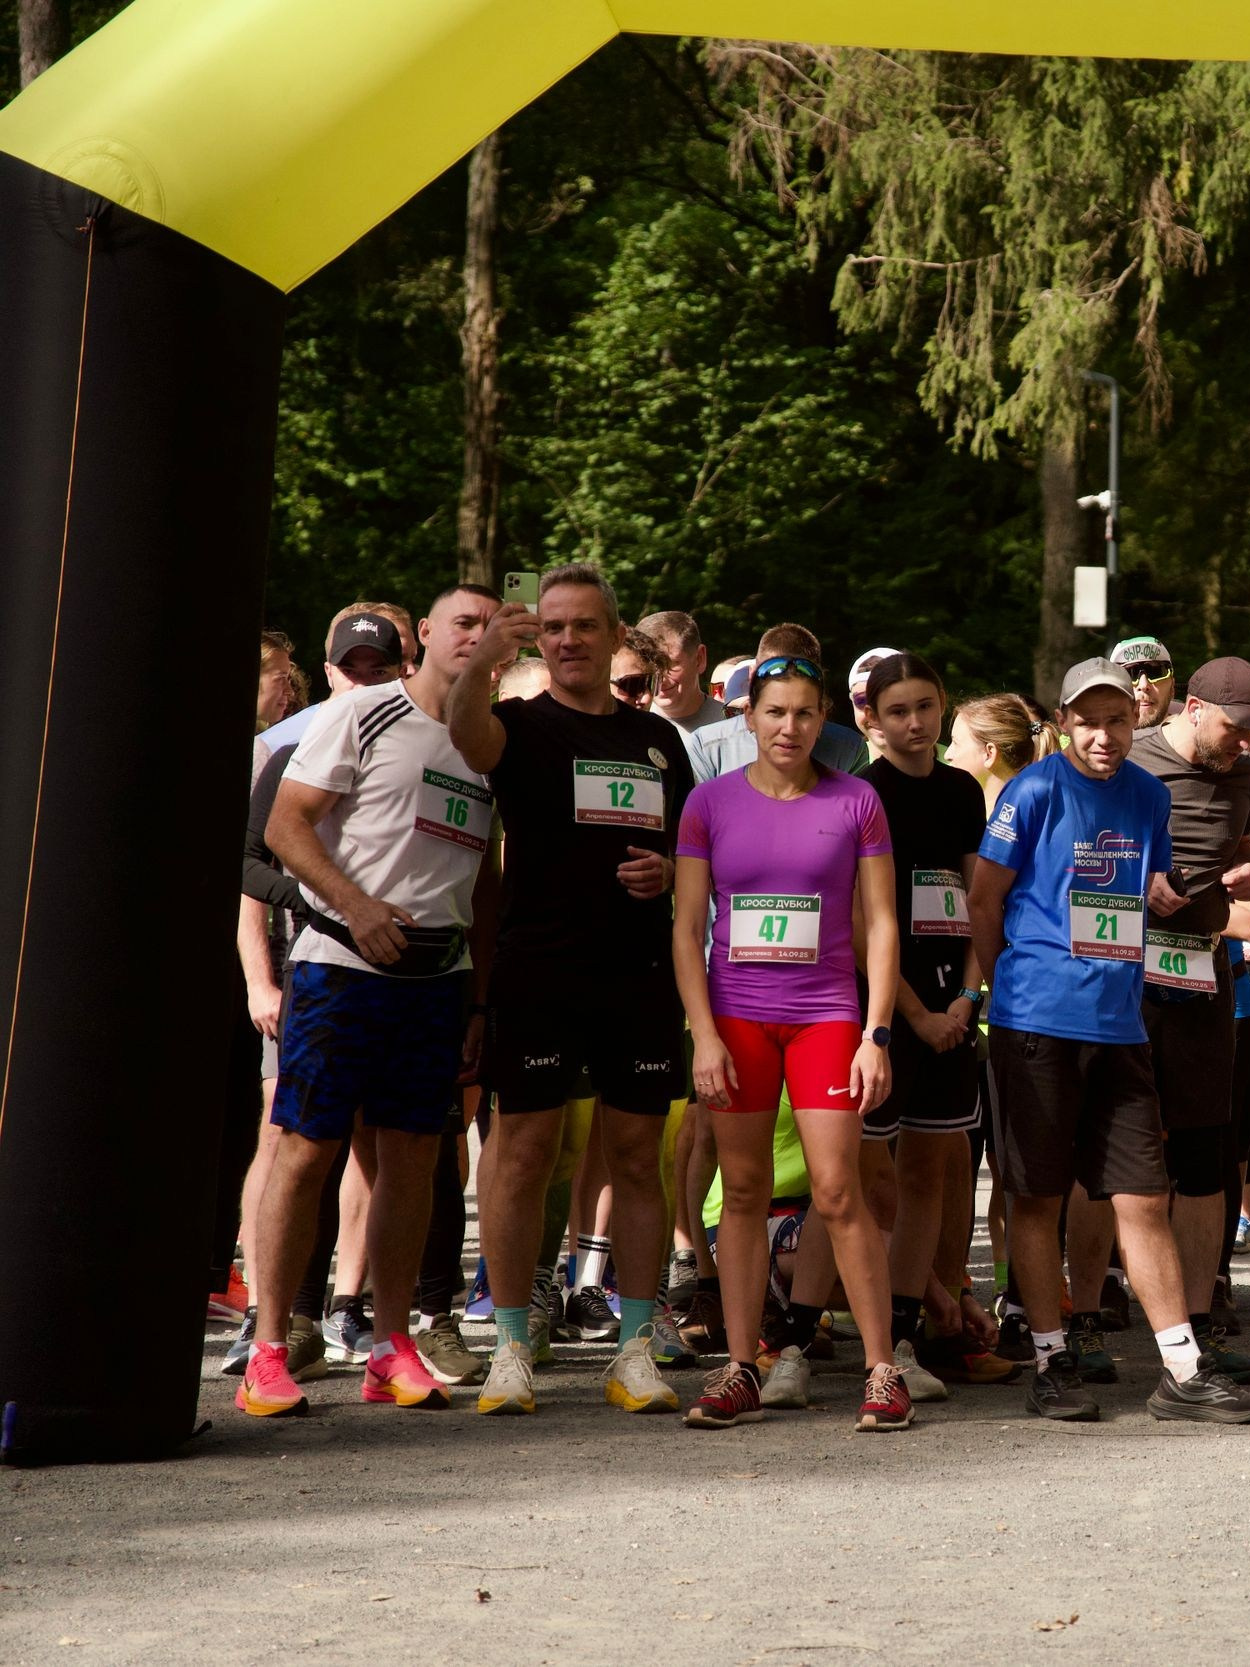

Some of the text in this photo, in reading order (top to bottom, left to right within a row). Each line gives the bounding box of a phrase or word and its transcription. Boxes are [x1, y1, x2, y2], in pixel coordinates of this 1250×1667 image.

[1123, 644, 1161, 661] ФЫР-ФЫР
[584, 765, 654, 779] КРОСС ДУБКИ
[430, 774, 460, 790] КРОСС
[606, 781, 635, 808] 12
[445, 796, 469, 827] 16
[1073, 851, 1140, 859] ПРОМЫШЛЕННОСТИ
[1074, 859, 1101, 867] МОСКВЫ
[921, 875, 948, 884] КРОСС
[740, 899, 811, 909] КРОСС ДУБКИ
[944, 890, 956, 917] 8
[1077, 896, 1136, 909] КРОСС ДУБКИ
[758, 915, 788, 942] 47
[1095, 913, 1118, 940] 21
[1111, 948, 1136, 956] 14.09.25
[1159, 951, 1188, 976] 40
[1181, 980, 1208, 989] 14.09.25
[529, 1057, 556, 1066] ASRV
[639, 1063, 667, 1071] ASRV
